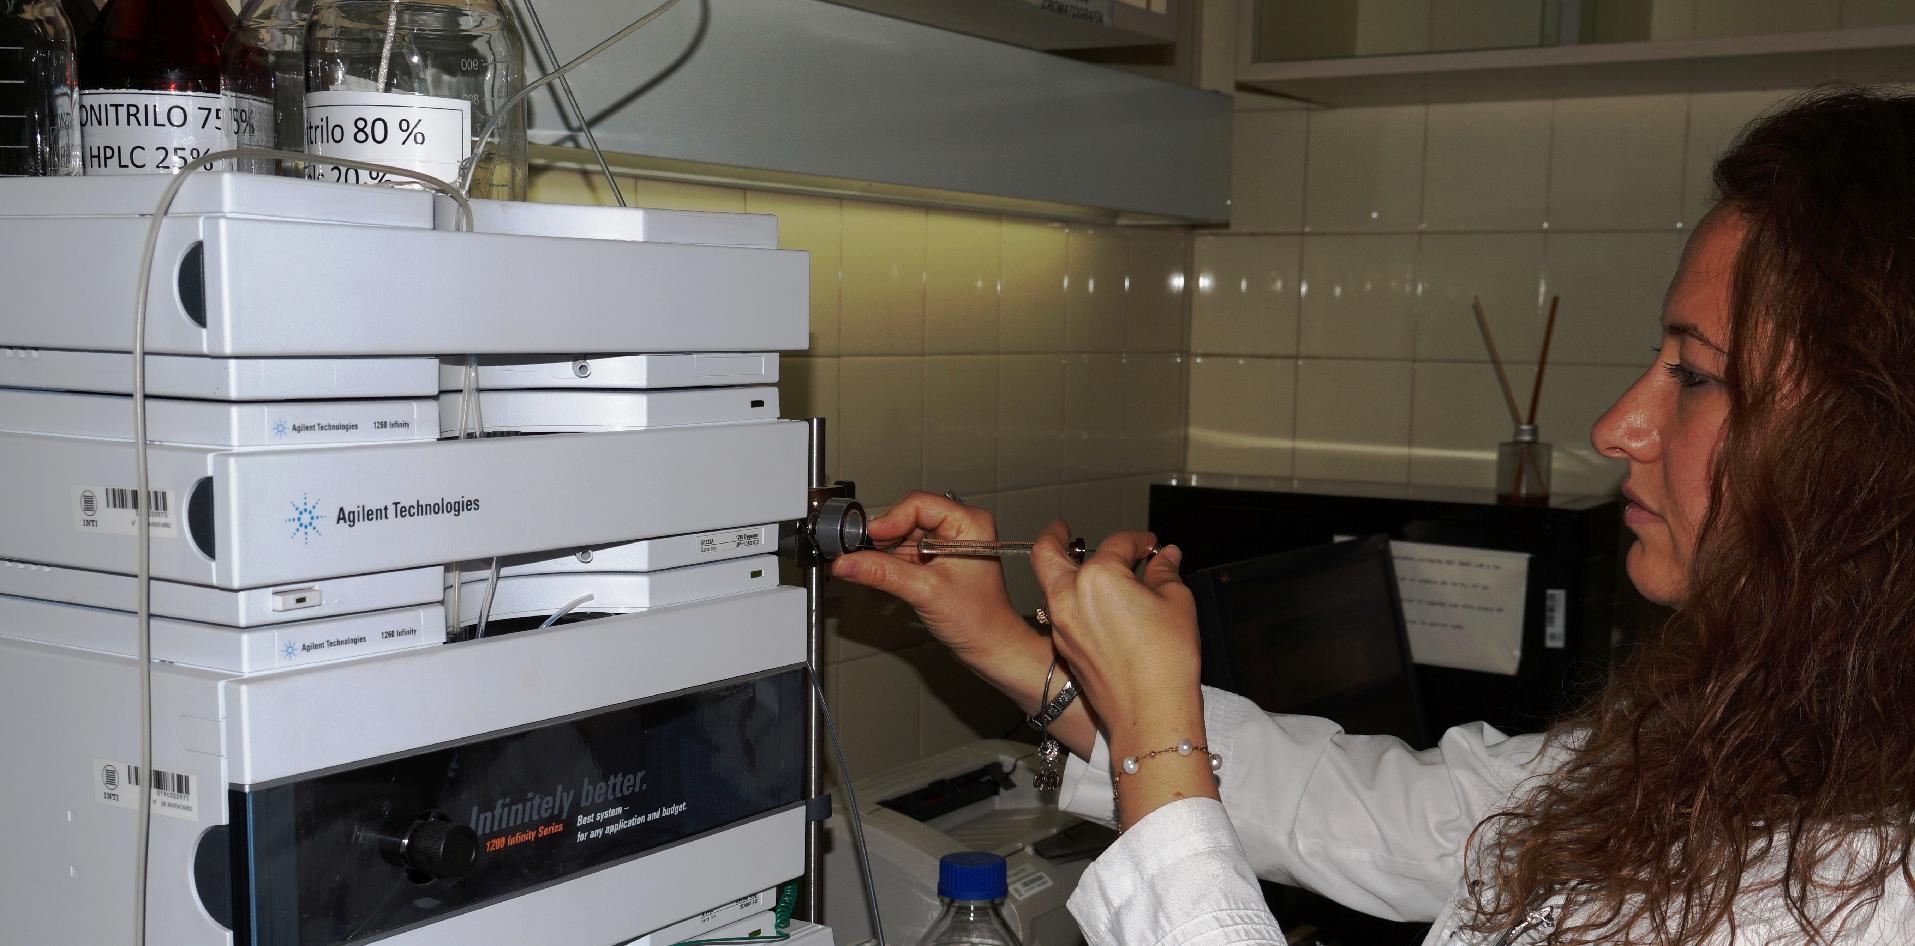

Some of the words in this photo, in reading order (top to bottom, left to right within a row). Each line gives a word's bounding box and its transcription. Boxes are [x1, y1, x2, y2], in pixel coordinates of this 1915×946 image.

[353, 117, 389, 144] 80
[398, 118, 426, 146] %
[89, 145, 146, 169] HPLC
[292, 423, 316, 433] Agilent
[317, 421, 359, 432] Technologies
[373, 420, 388, 430] 1260
[389, 420, 410, 430] Infinity
[336, 504, 389, 528] Agilent
[392, 496, 480, 519] Technologies
[82, 519, 98, 528] INTI
[396, 627, 417, 637] Infinity
[301, 641, 325, 653] Agilent
[326, 635, 367, 649] Technologies
[104, 791, 120, 801] INTI
[470, 783, 575, 835] Infinitely
[580, 769, 648, 808] better.
[576, 813, 596, 827] Best
[596, 805, 623, 823] system
[576, 830, 589, 843] for
[589, 827, 604, 840] any
[604, 814, 646, 835] application
[647, 808, 661, 822] and
[661, 801, 688, 818] budget.
[486, 836, 507, 852] 1200
[507, 829, 537, 847] Infinity
[538, 821, 564, 838] Series
